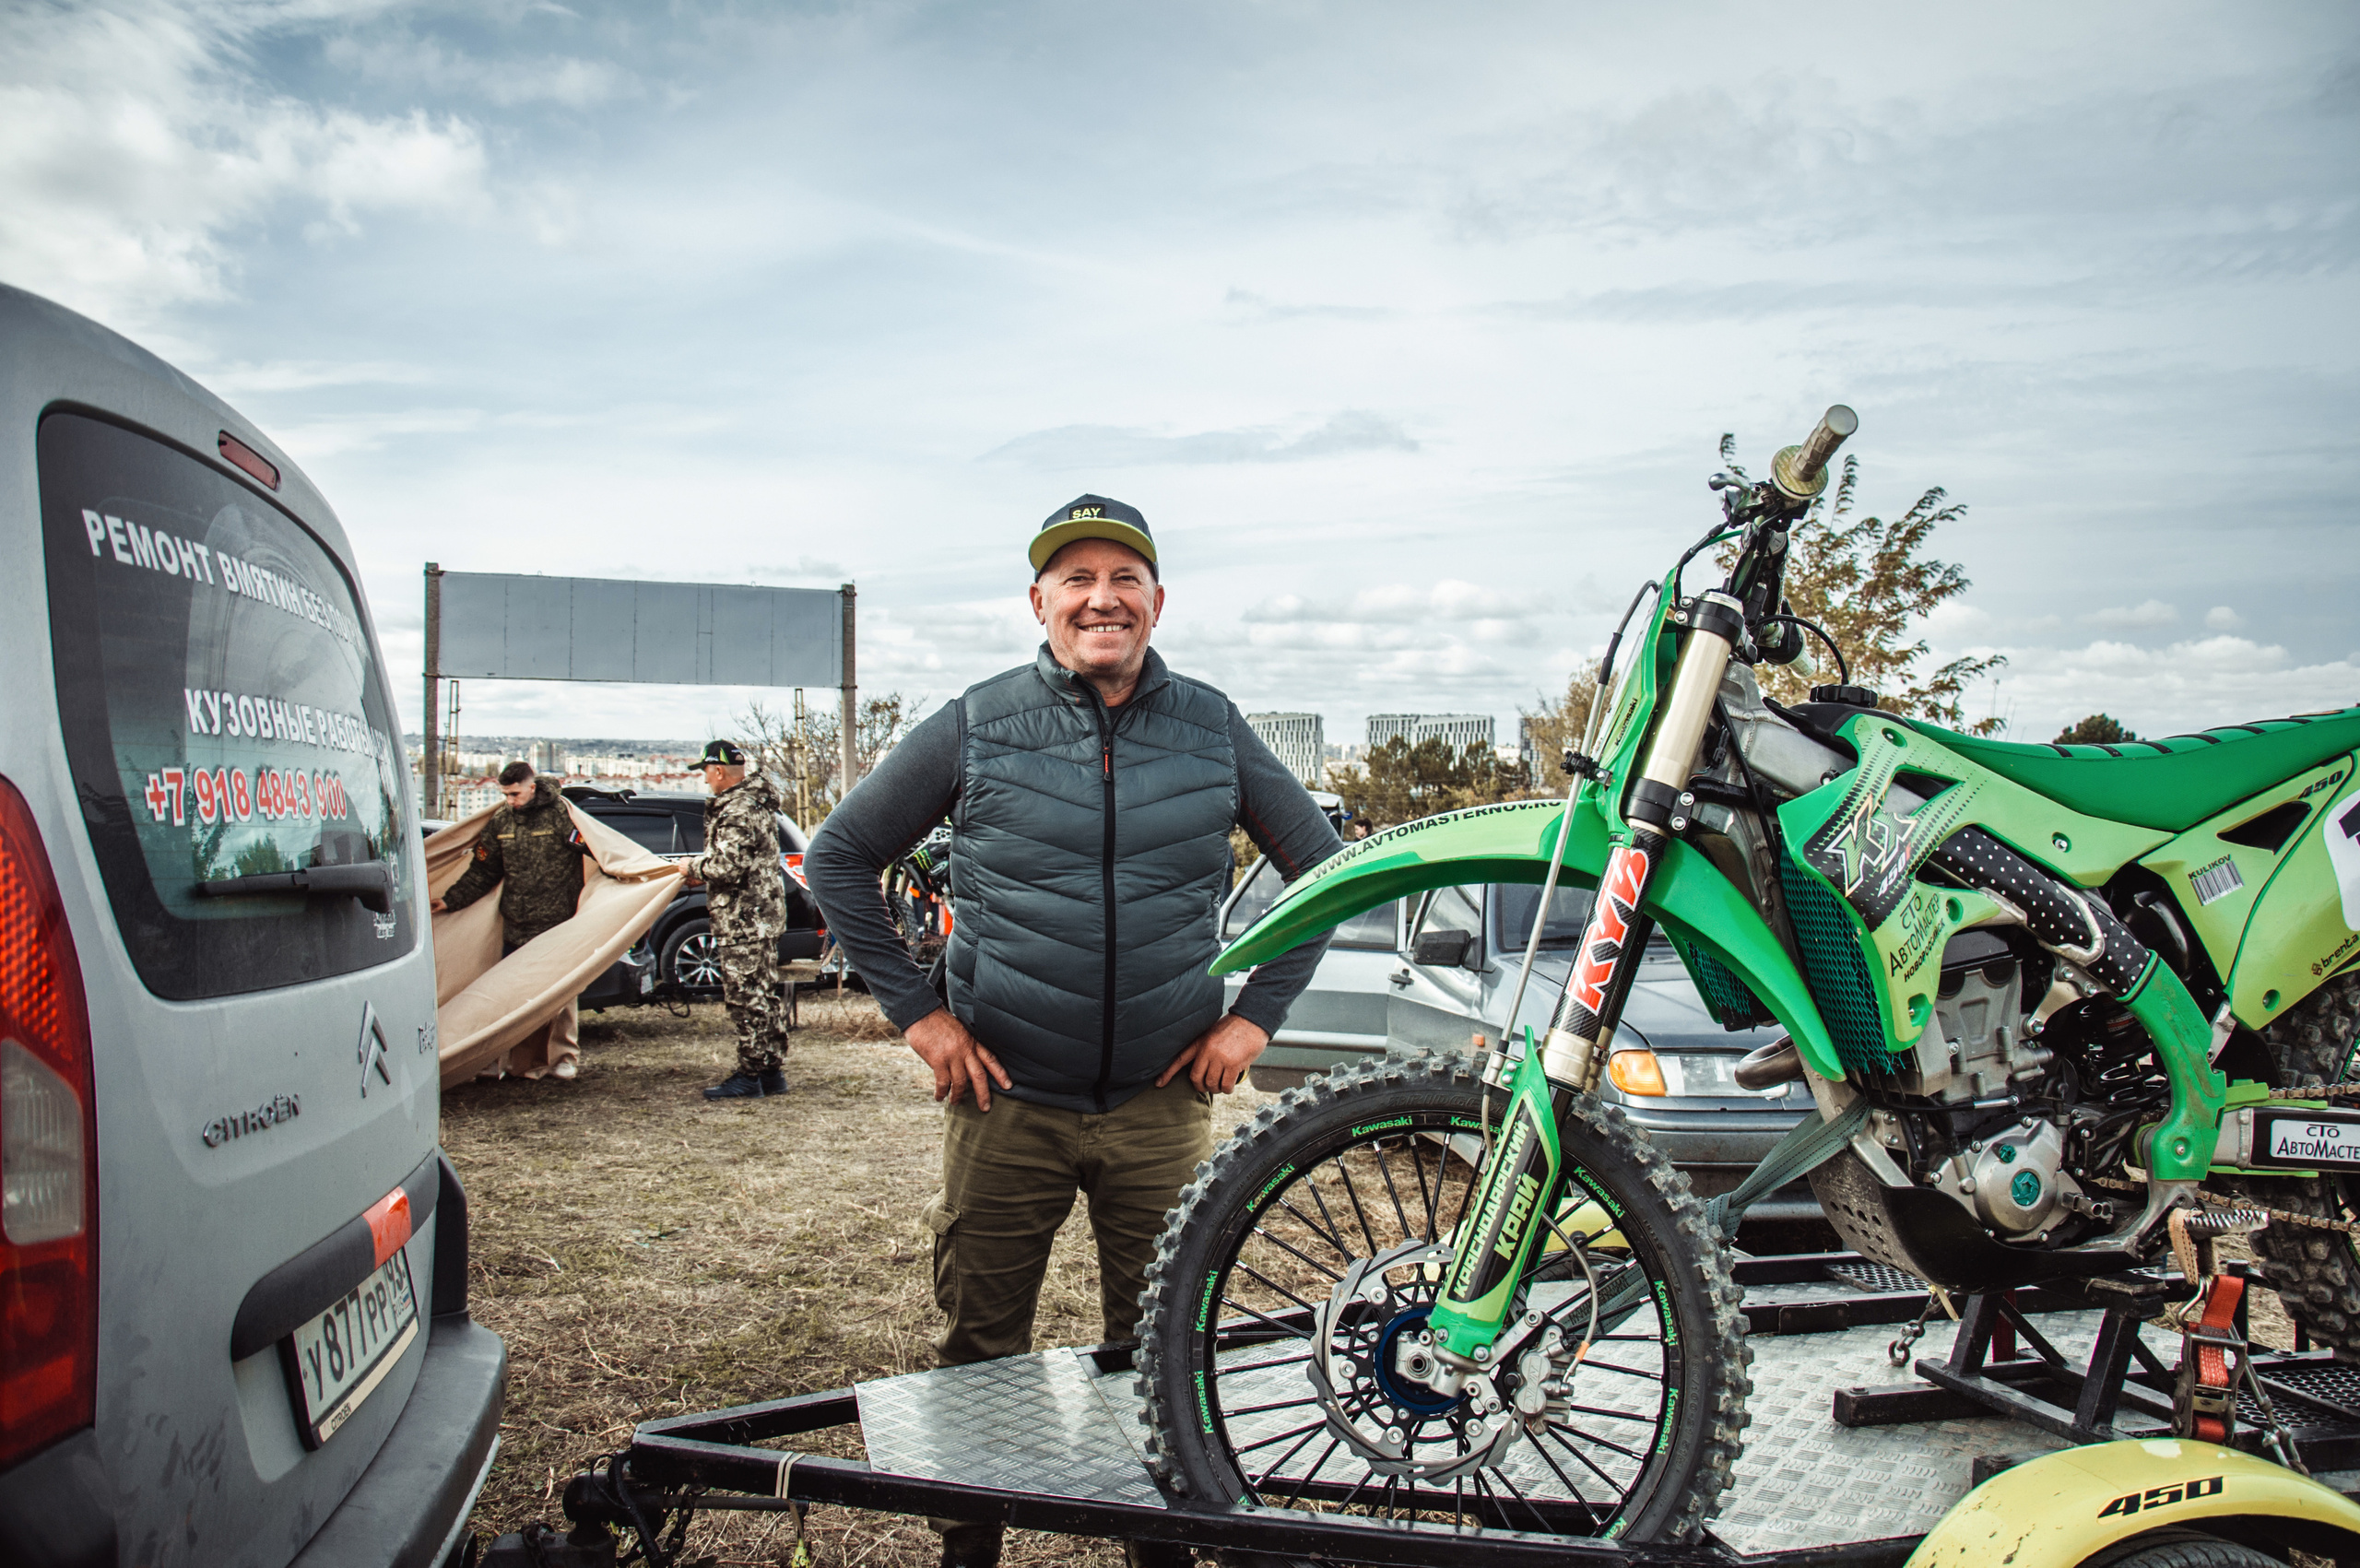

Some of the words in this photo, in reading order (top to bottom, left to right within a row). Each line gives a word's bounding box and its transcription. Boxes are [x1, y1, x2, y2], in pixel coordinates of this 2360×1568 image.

[1072, 508, 1101, 519] SAY
[82, 509, 215, 586] РЕМОНТ
[217, 550, 305, 619] ВМЯТИН
[300, 587, 332, 632] БЕЗ
[184, 688, 317, 747] КУЗОВНЫЕ
[316, 708, 372, 758] РАБОТЫ
[1614, 697, 1639, 747] Kawasaki
[145, 766, 185, 827] +7
[194, 766, 252, 824] 918
[256, 766, 312, 821] 4843
[313, 771, 348, 821] 900
[2298, 771, 2342, 799] 450
[2188, 854, 2231, 879] KULIKOV
[1565, 845, 1650, 1017] KYB
[1900, 892, 1923, 930] СТО
[1904, 918, 1946, 983] НОВОРОССИЙСК
[2320, 934, 2359, 968] brenta
[203, 1093, 301, 1148] CITROËN
[1351, 1116, 1412, 1137] Kawasaki
[2307, 1124, 2340, 1138] СТО
[1246, 1163, 1295, 1212] Kawasaki
[1454, 1120, 1530, 1299] КРАСНОДАРСКИЙ
[1574, 1166, 1625, 1219] Kawasaki
[1493, 1172, 1540, 1261] КРАЙ
[1195, 1270, 1219, 1333] Kawasaki
[1654, 1280, 1679, 1348] Kawasaki
[1195, 1370, 1214, 1434] Kawasaki
[1656, 1387, 1679, 1455] Kawasaki
[2097, 1476, 2224, 1518] 450
